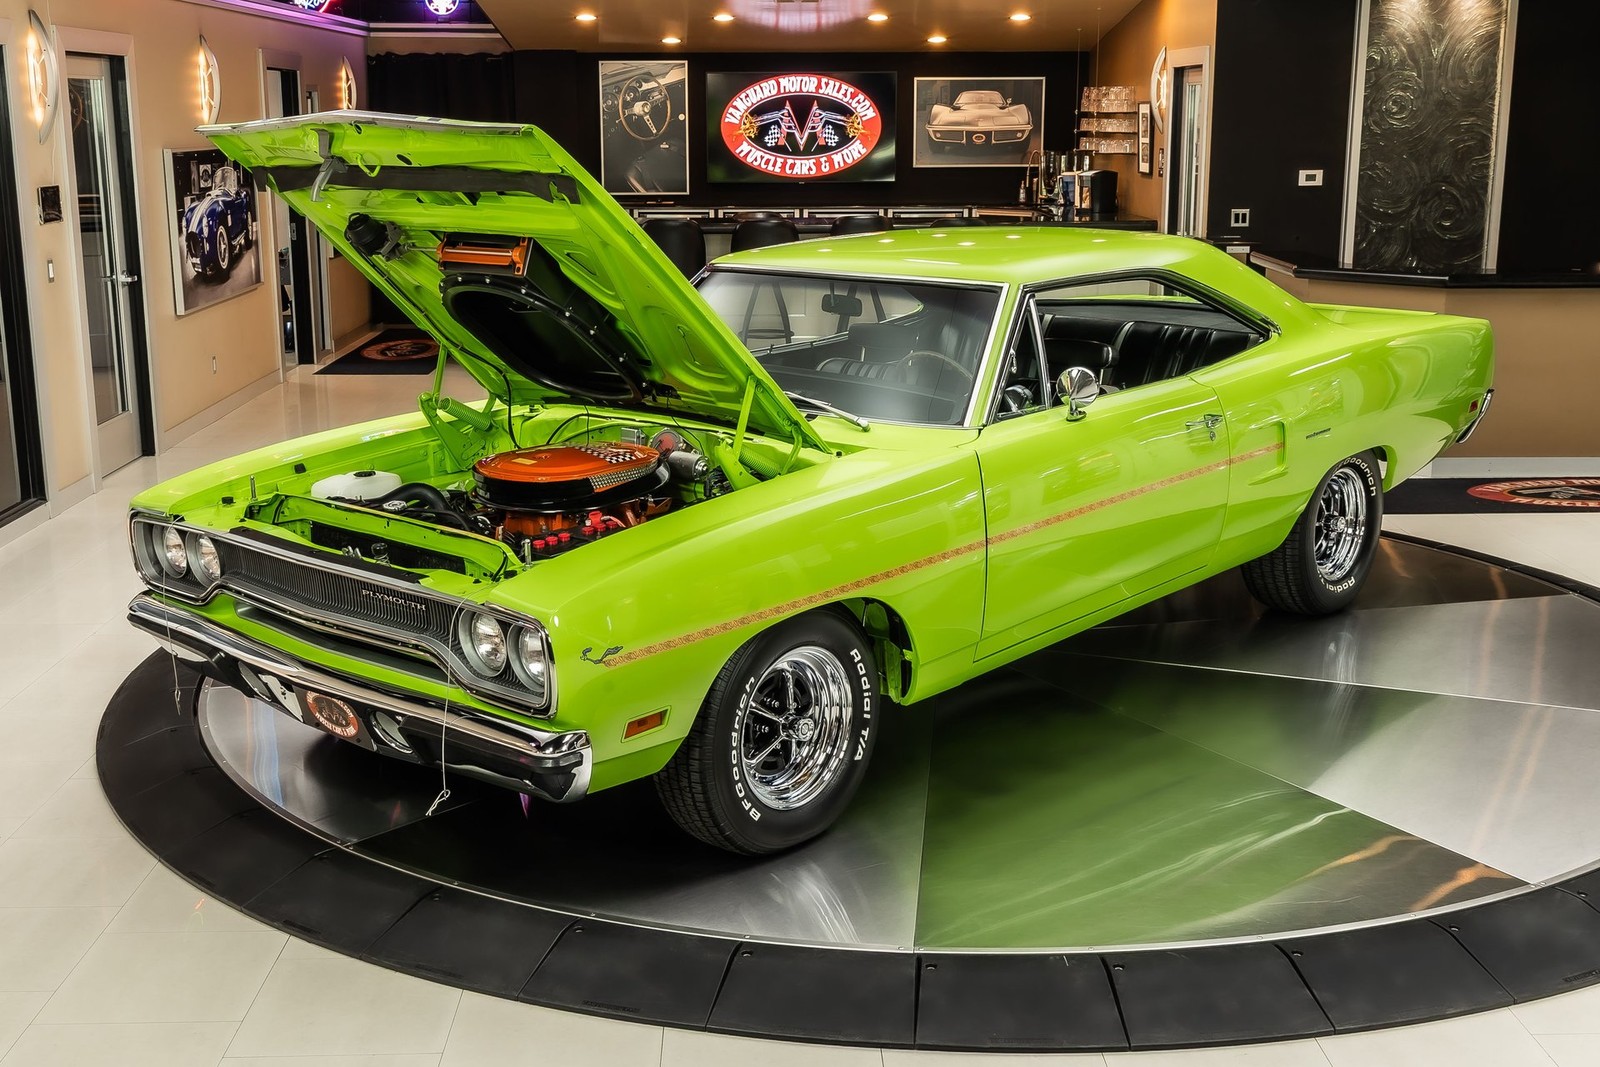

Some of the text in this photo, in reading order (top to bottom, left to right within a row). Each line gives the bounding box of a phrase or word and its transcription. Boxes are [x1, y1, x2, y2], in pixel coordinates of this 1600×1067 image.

[725, 76, 877, 124] VANGUARD MOTOR SALES.COM
[735, 140, 867, 175] MUSCLE CARS & MORE
[362, 589, 426, 611] PLYMOUTH
[1326, 576, 1356, 594] Radial
[850, 648, 871, 761] Radial T/A
[731, 676, 761, 822] BFGoodrich
